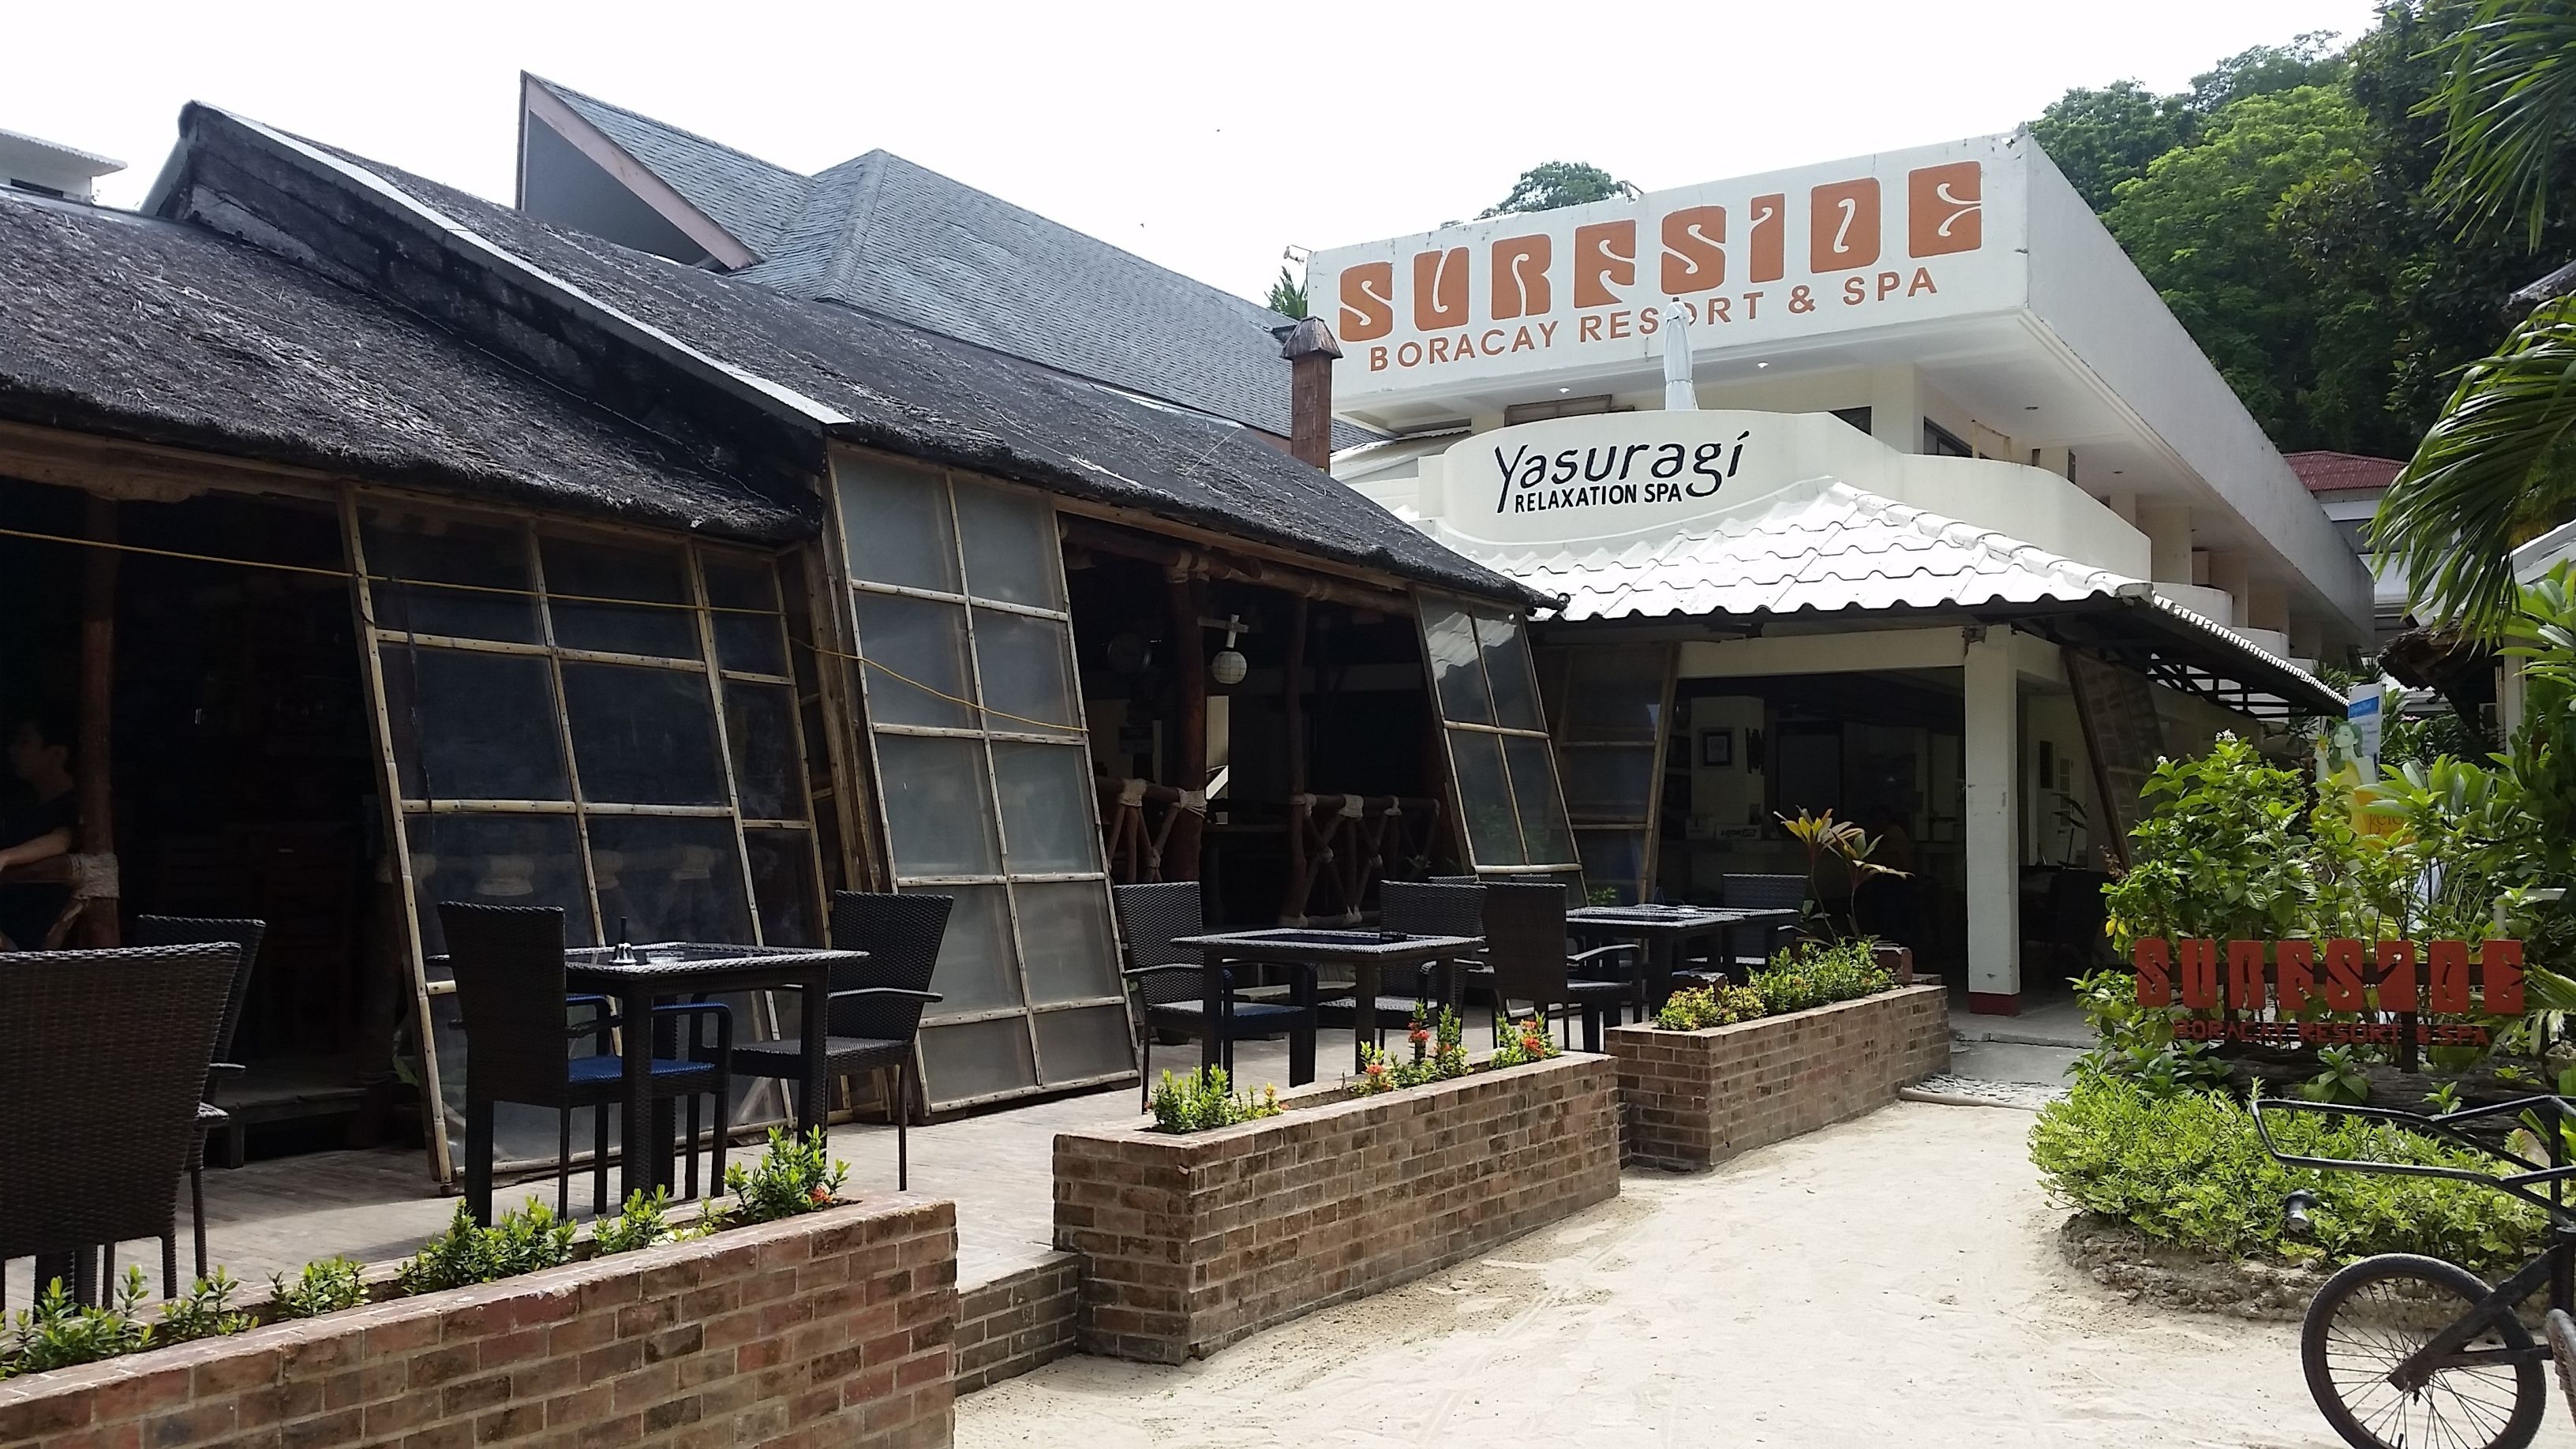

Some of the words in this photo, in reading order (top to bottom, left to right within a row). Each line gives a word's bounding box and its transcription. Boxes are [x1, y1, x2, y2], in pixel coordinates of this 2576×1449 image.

[1339, 161, 1983, 342] SURFSIDE
[1370, 320, 1559, 372] BORACAY
[1788, 284, 1816, 315] &
[1843, 267, 1938, 305] SPA
[1494, 430, 1750, 514] Yasuragi
[1515, 484, 1638, 514] RELAXATION
[1643, 483, 1683, 504] SPA
[2174, 1019, 2290, 1042] BORACAY
[2297, 1023, 2402, 1046] RESORT
[2437, 1024, 2490, 1046] SPA
